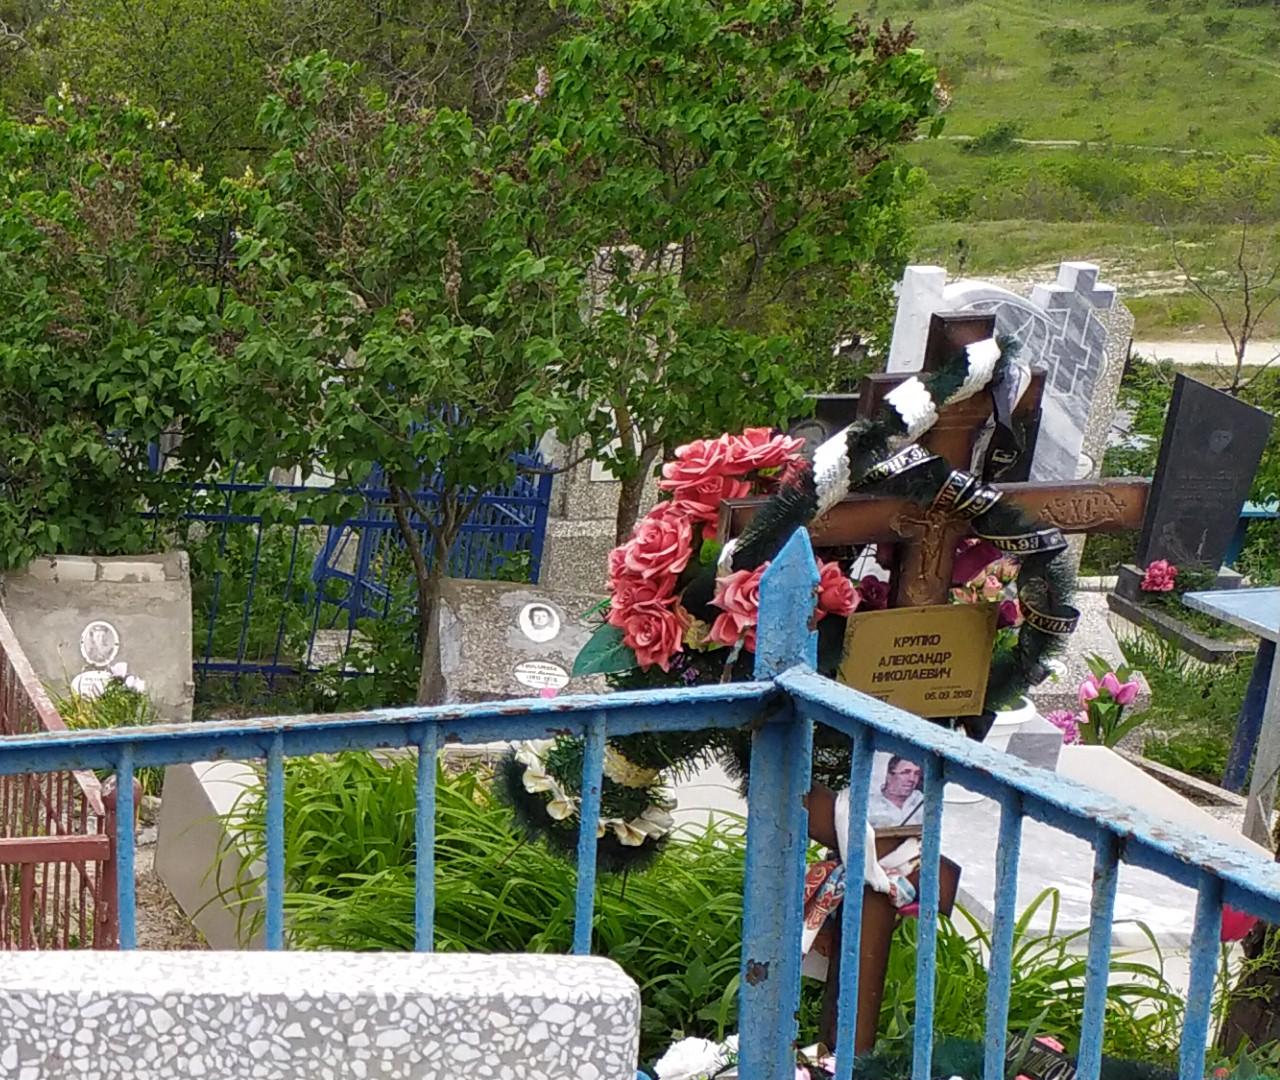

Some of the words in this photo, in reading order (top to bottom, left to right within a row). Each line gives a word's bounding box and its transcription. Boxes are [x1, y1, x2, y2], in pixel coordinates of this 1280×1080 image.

[893, 634, 941, 648] КРУПКО
[878, 651, 952, 668] АЛЕКСАНДР
[872, 667, 952, 683] НИКОЛАЕВИЧ
